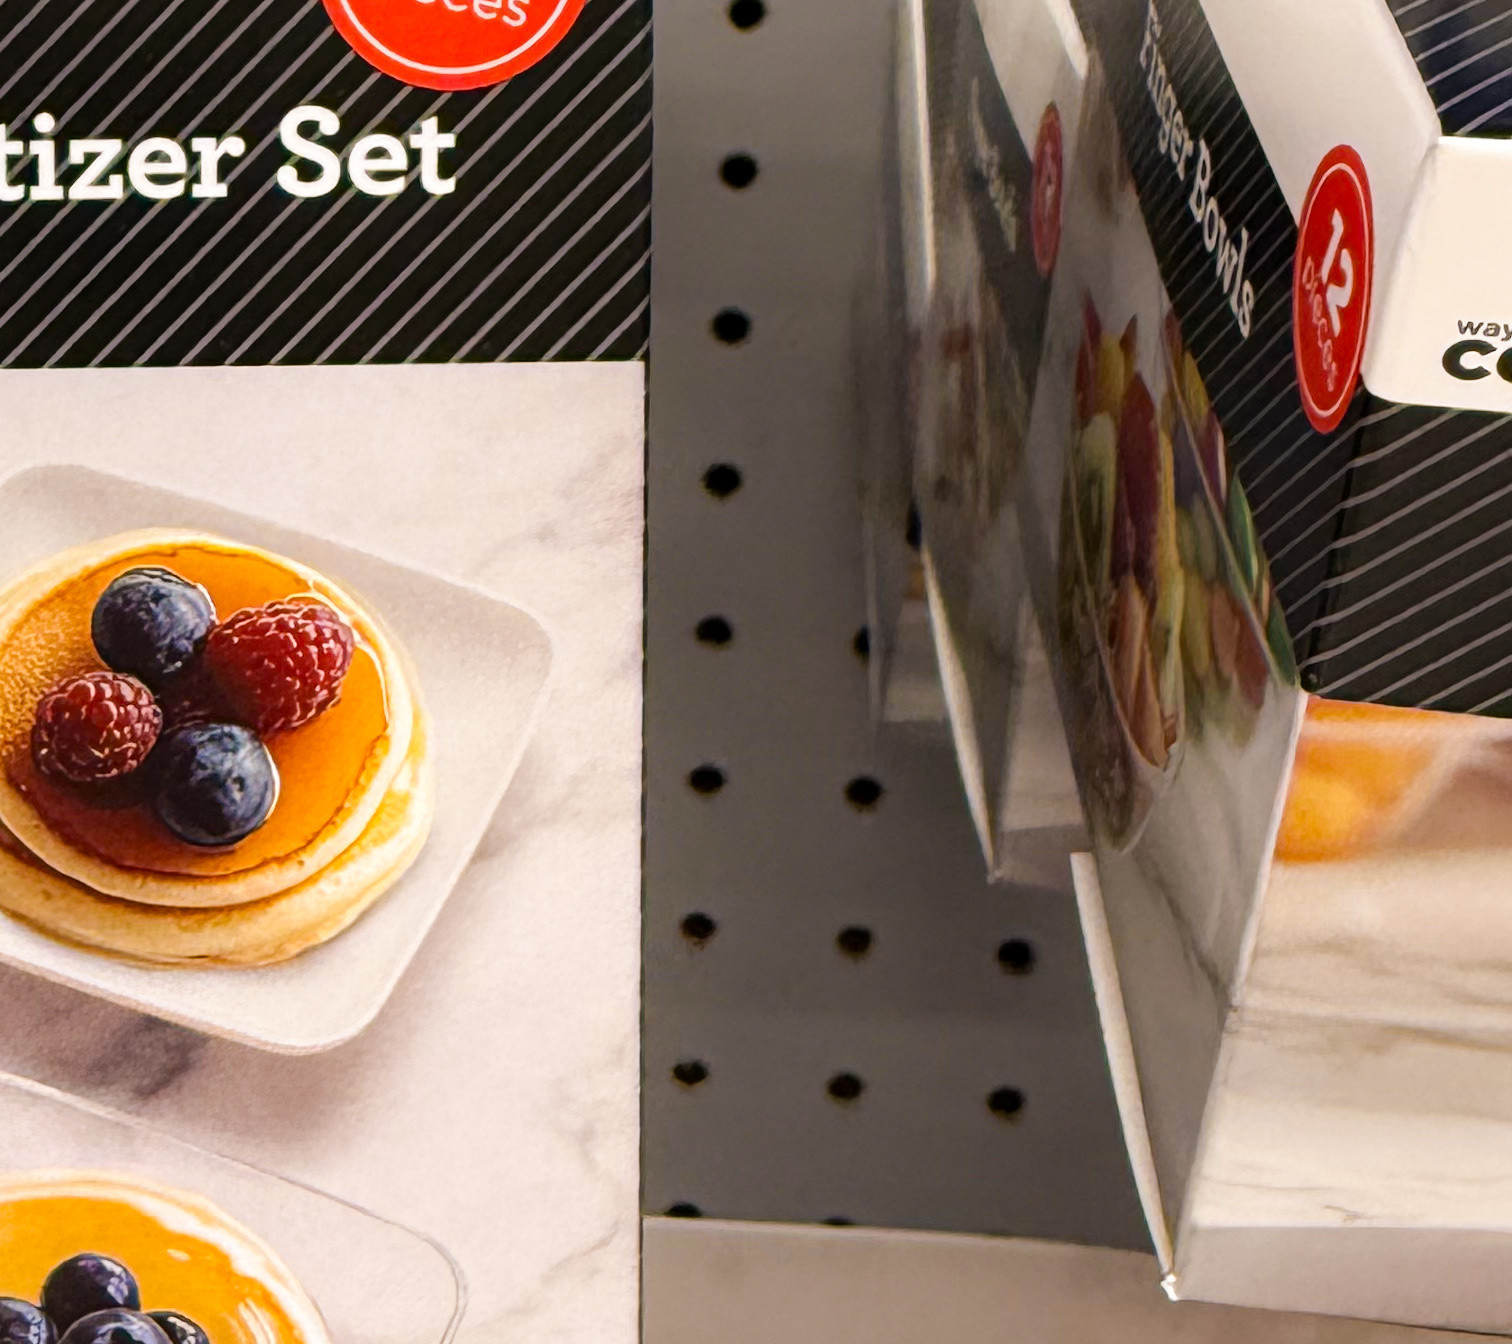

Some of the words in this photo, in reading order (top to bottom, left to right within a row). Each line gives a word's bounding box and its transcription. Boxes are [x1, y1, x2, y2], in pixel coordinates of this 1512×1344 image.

[276, 105, 456, 198] Set
[1189, 138, 1255, 339] Bowls
[1321, 208, 1354, 338] 12
